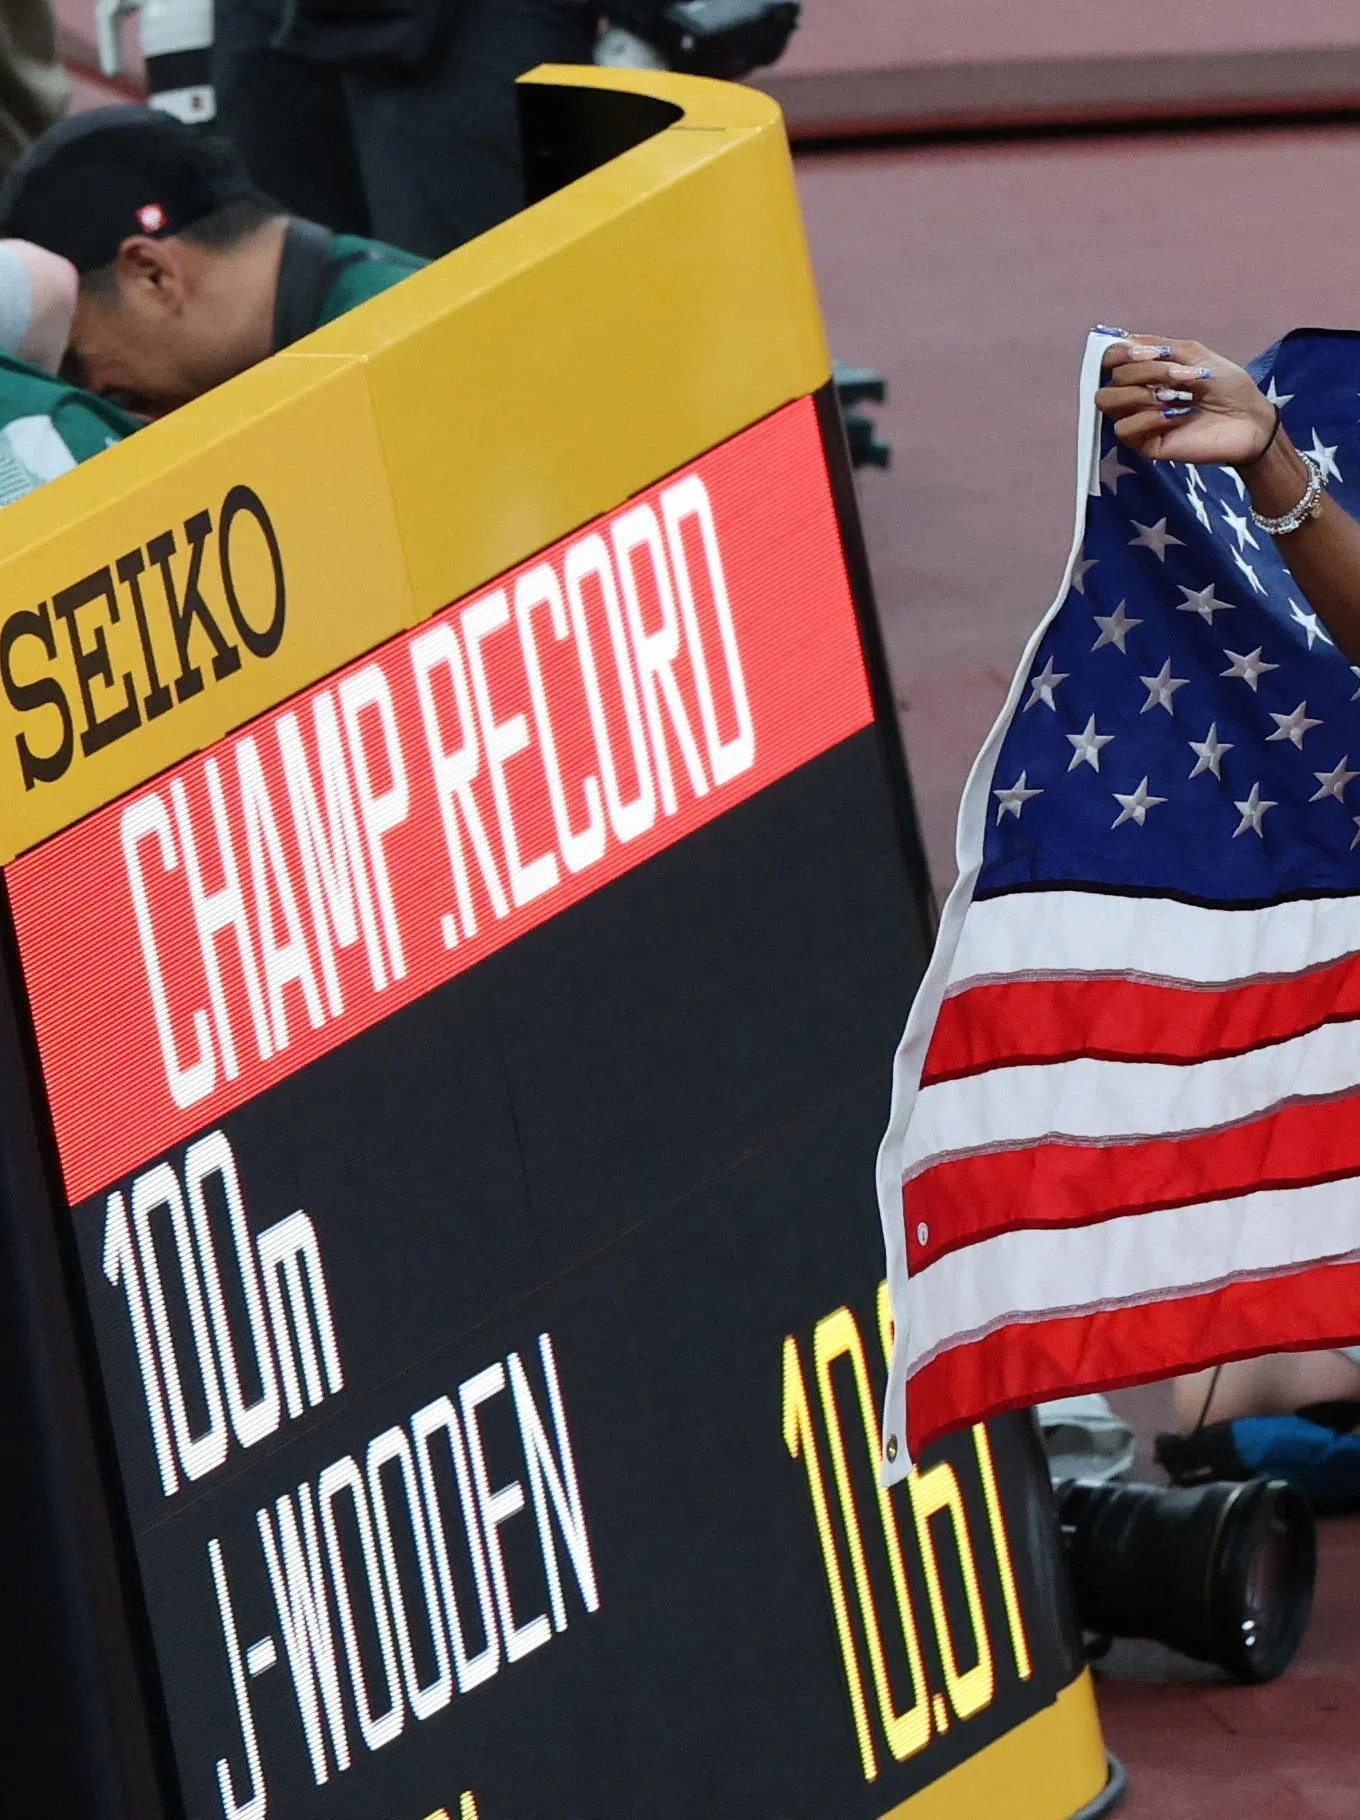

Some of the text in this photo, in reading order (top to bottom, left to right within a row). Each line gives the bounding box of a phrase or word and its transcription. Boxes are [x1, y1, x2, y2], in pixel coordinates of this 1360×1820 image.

[1, 484, 286, 792] SEIKO
[104, 1130, 344, 1496] 100m
[208, 1332, 600, 1820] J-WOODEN
